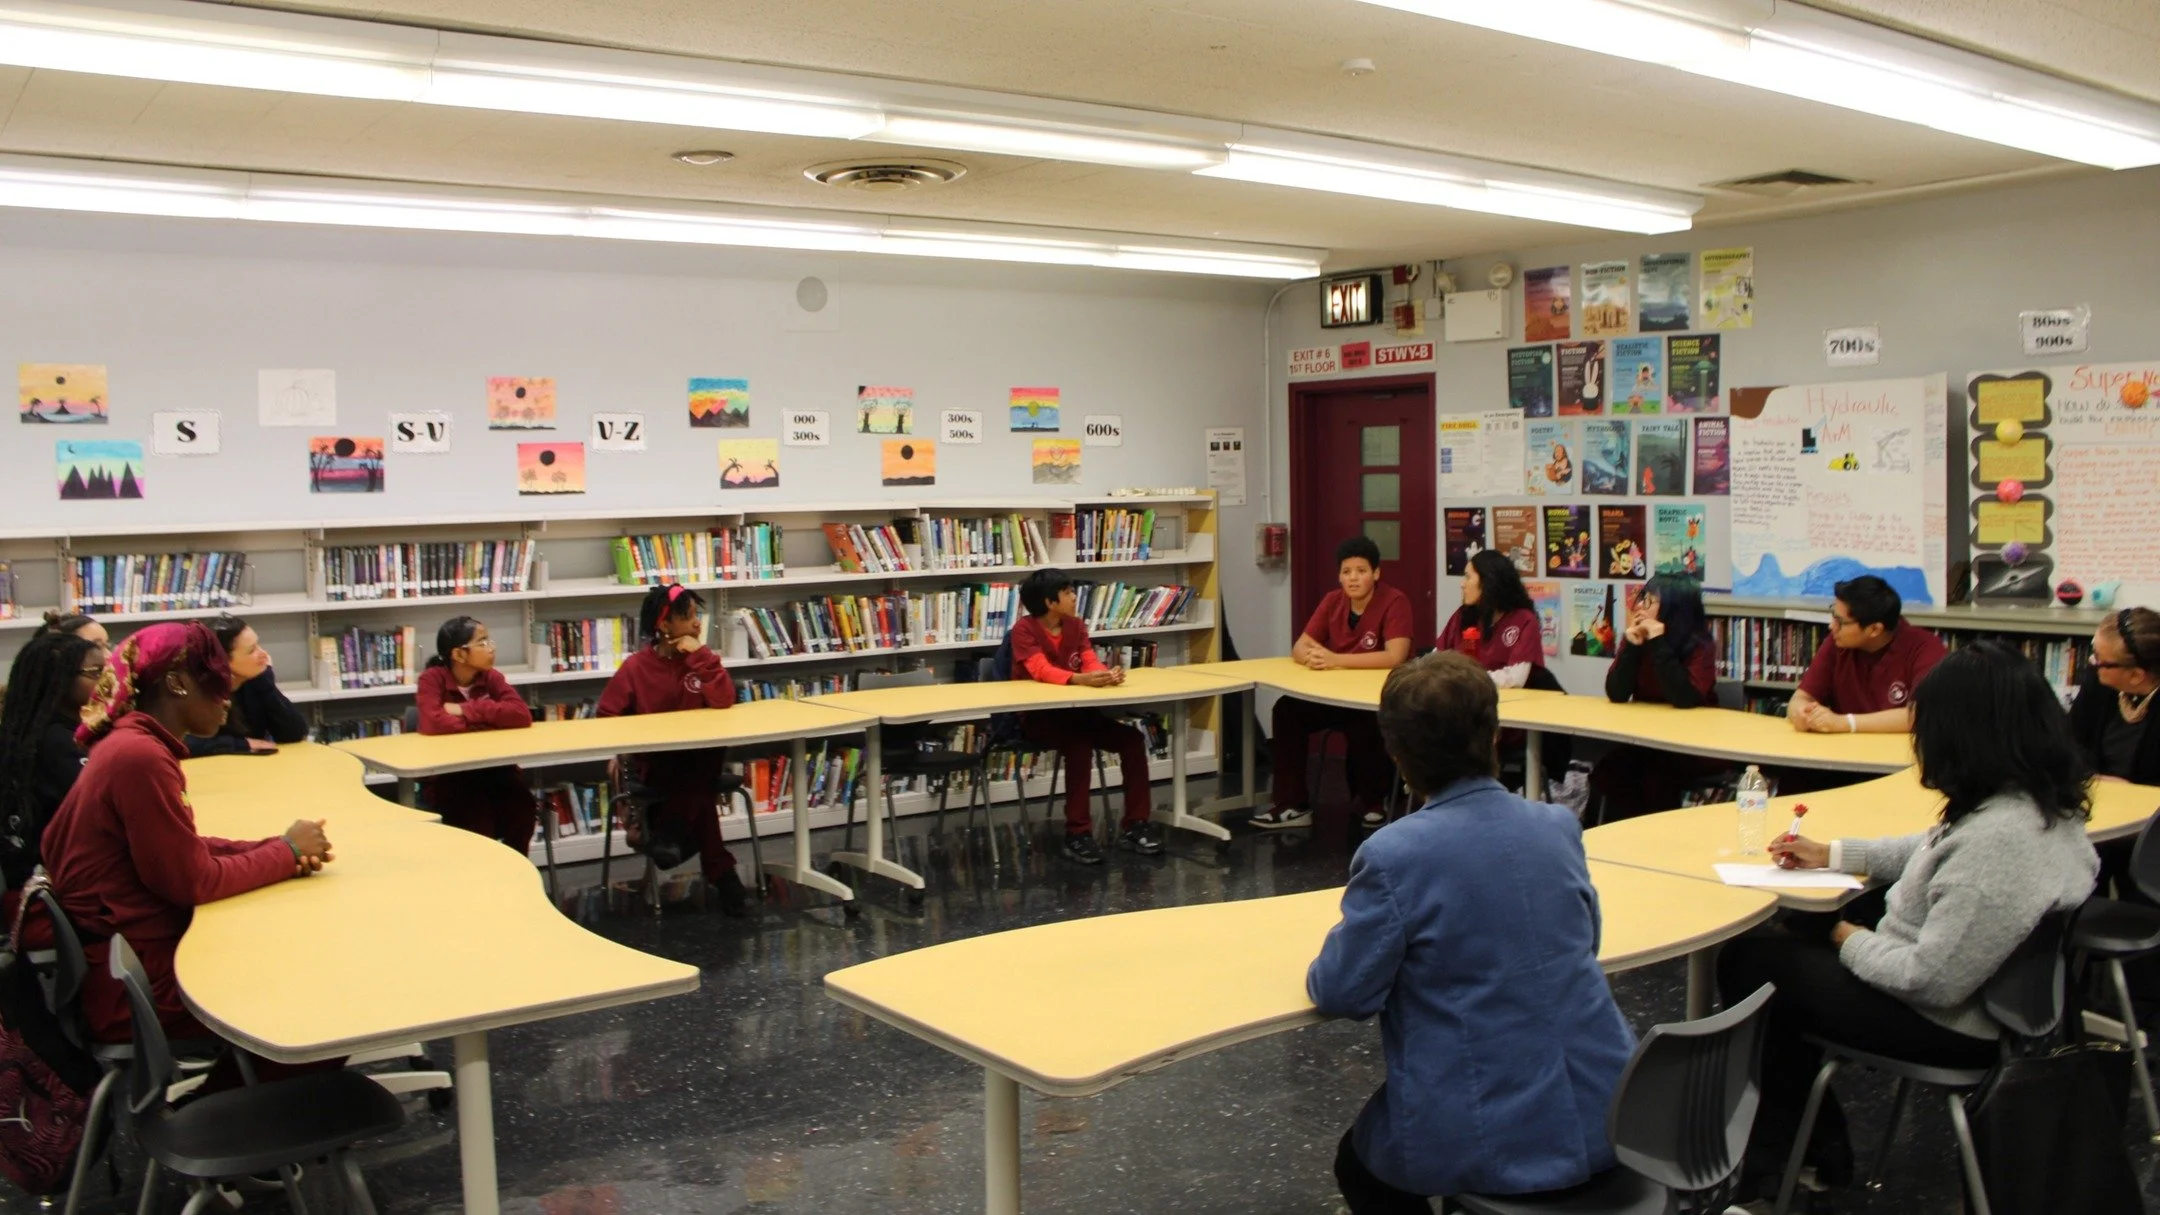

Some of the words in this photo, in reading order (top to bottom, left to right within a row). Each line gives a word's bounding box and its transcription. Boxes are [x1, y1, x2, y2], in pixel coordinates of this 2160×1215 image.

[1331, 283, 1362, 325] EXIT
[1671, 338, 1700, 348] SCIENCE
[1829, 337, 1876, 354] 700s
[1294, 350, 1315, 362] EXIT
[1316, 350, 1323, 359] #
[1325, 348, 1331, 358] 6
[1378, 345, 1429, 362] STWY-B
[1560, 347, 1587, 356] FICTION
[1671, 347, 1700, 356] FICTION
[1304, 361, 1336, 374] FLOOR
[1698, 420, 1725, 429] ANIMAL
[176, 420, 197, 443] S
[949, 429, 974, 439] 500s
[1086, 423, 1120, 437] 600s
[1698, 428, 1727, 437] FICTION
[792, 431, 820, 441] 300s
[1602, 510, 1625, 518] DRAMA
[1659, 508, 1688, 516] GRAPHIC
